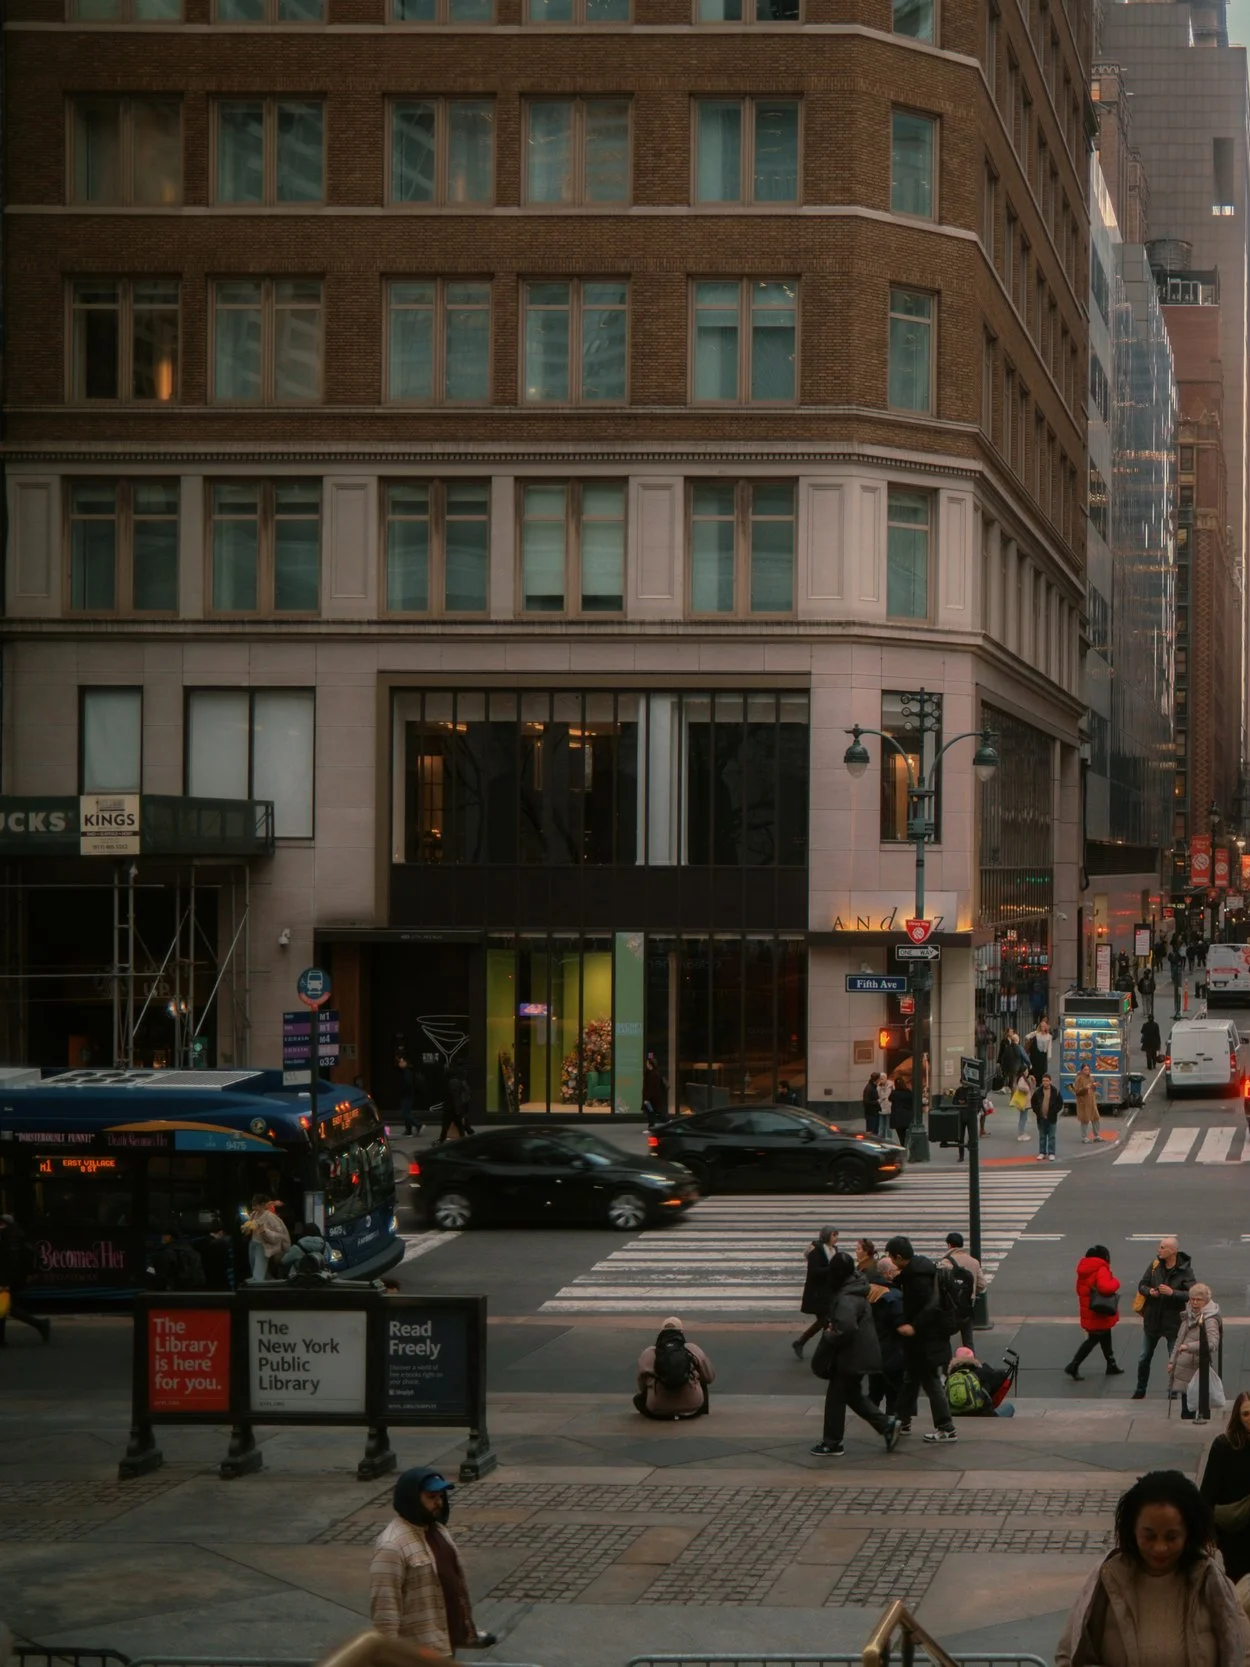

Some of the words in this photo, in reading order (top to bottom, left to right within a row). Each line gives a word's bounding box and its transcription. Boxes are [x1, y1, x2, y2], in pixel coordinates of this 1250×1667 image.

[84, 813, 135, 827] KINGS
[833, 906, 945, 932] ANdZ
[856, 979, 878, 989] Fifth
[880, 979, 897, 989] Ave
[39, 1159, 52, 1172] M1
[62, 1159, 82, 1167] EAST
[83, 1159, 116, 1167] VILLAGE
[37, 1239, 99, 1272] Becomes
[93, 1240, 127, 1269] Her
[153, 1317, 186, 1334] The
[257, 1319, 290, 1336] The
[389, 1319, 432, 1337] Read
[154, 1336, 219, 1357] Library
[258, 1338, 297, 1354] New
[302, 1337, 340, 1354] York
[389, 1339, 441, 1360] Freely
[154, 1355, 168, 1371] is
[173, 1355, 212, 1372] here
[258, 1356, 311, 1373] Public
[154, 1373, 181, 1390] for
[184, 1376, 222, 1395] you.
[259, 1375, 321, 1396] Library
